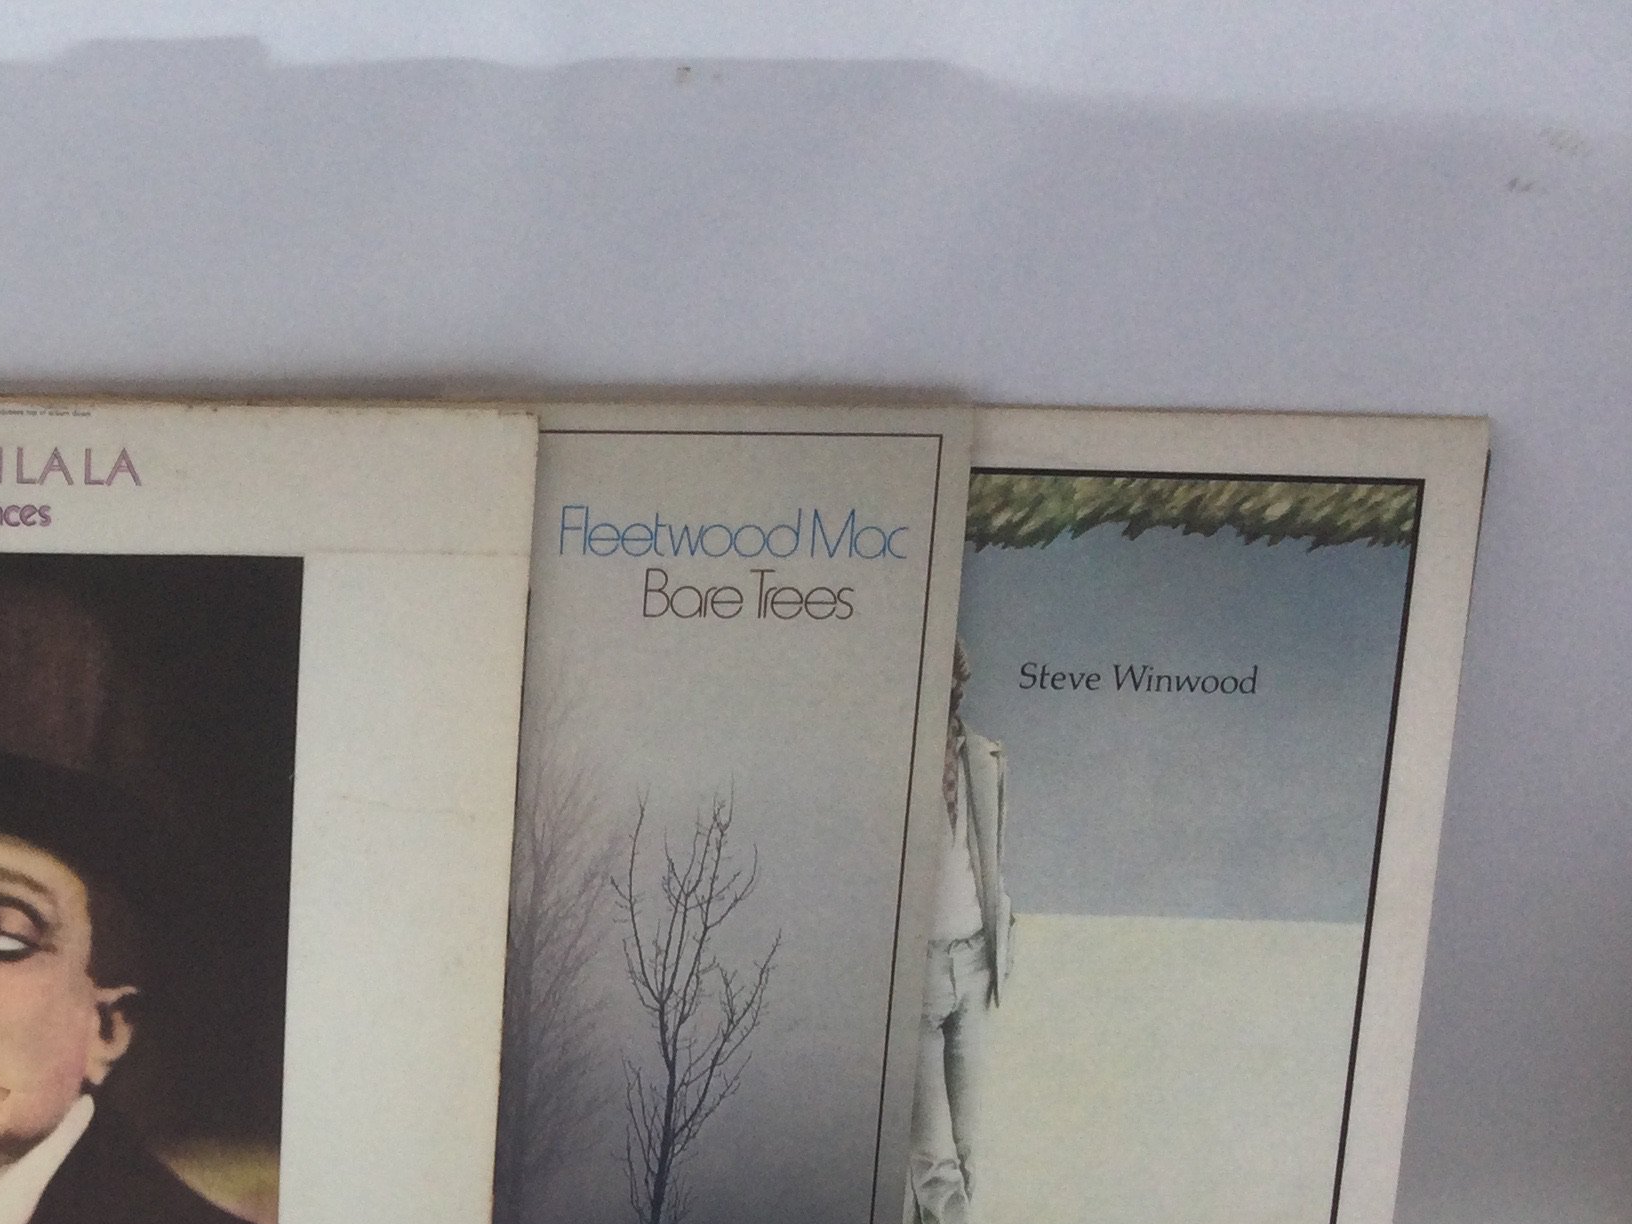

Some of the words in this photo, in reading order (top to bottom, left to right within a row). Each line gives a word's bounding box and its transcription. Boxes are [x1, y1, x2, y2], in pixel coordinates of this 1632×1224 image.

[16, 446, 75, 486] LA
[83, 447, 143, 487] LA
[559, 504, 803, 558] Fleetwood
[810, 507, 910, 560] Mac
[642, 567, 744, 619] Bare
[749, 568, 855, 620] Trees
[1019, 661, 1102, 691] Steve
[1113, 663, 1259, 695] Winwood
